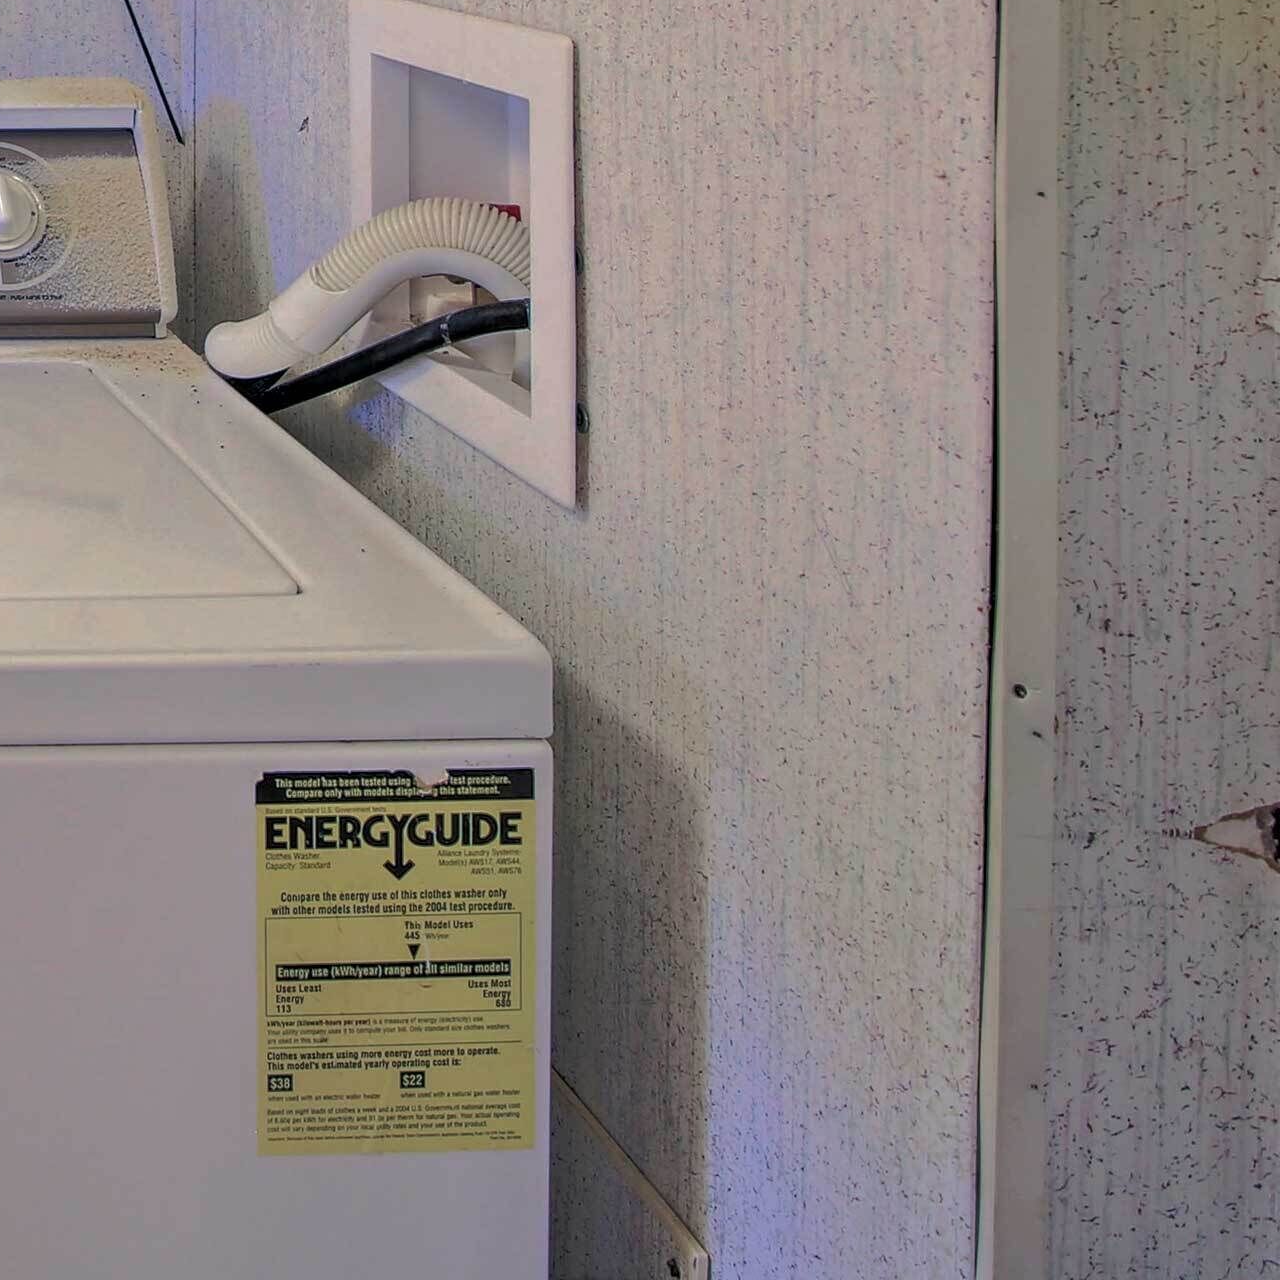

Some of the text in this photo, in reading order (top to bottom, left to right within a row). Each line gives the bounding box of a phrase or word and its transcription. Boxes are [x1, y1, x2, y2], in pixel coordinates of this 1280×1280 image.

[274, 774, 511, 788] This model has been tested using test procedure.
[285, 785, 501, 800] Compare only with models this statement.
[265, 811, 522, 850] ENERGYGUIDE
[280, 888, 508, 904] Compare the energy use of this clothes washer only
[271, 901, 516, 915] with other models tested using the 2004 test procedure.
[404, 920, 474, 930] This Model Uses
[404, 931, 420, 940] 445
[277, 962, 509, 979] Energy use (kWh/year) range of all similar models
[275, 984, 322, 993] Uses Least
[467, 979, 511, 988] Uses Most
[275, 995, 305, 1005] Energy
[482, 989, 511, 1000] Energy
[276, 1005, 292, 1013] 113
[266, 1047, 501, 1061] Clothes washers using more energy cost more to operate.
[267, 1057, 462, 1071] This model's estimated yearly operating cost is:
[270, 1078, 291, 1090] $38
[402, 1074, 423, 1087] $22
